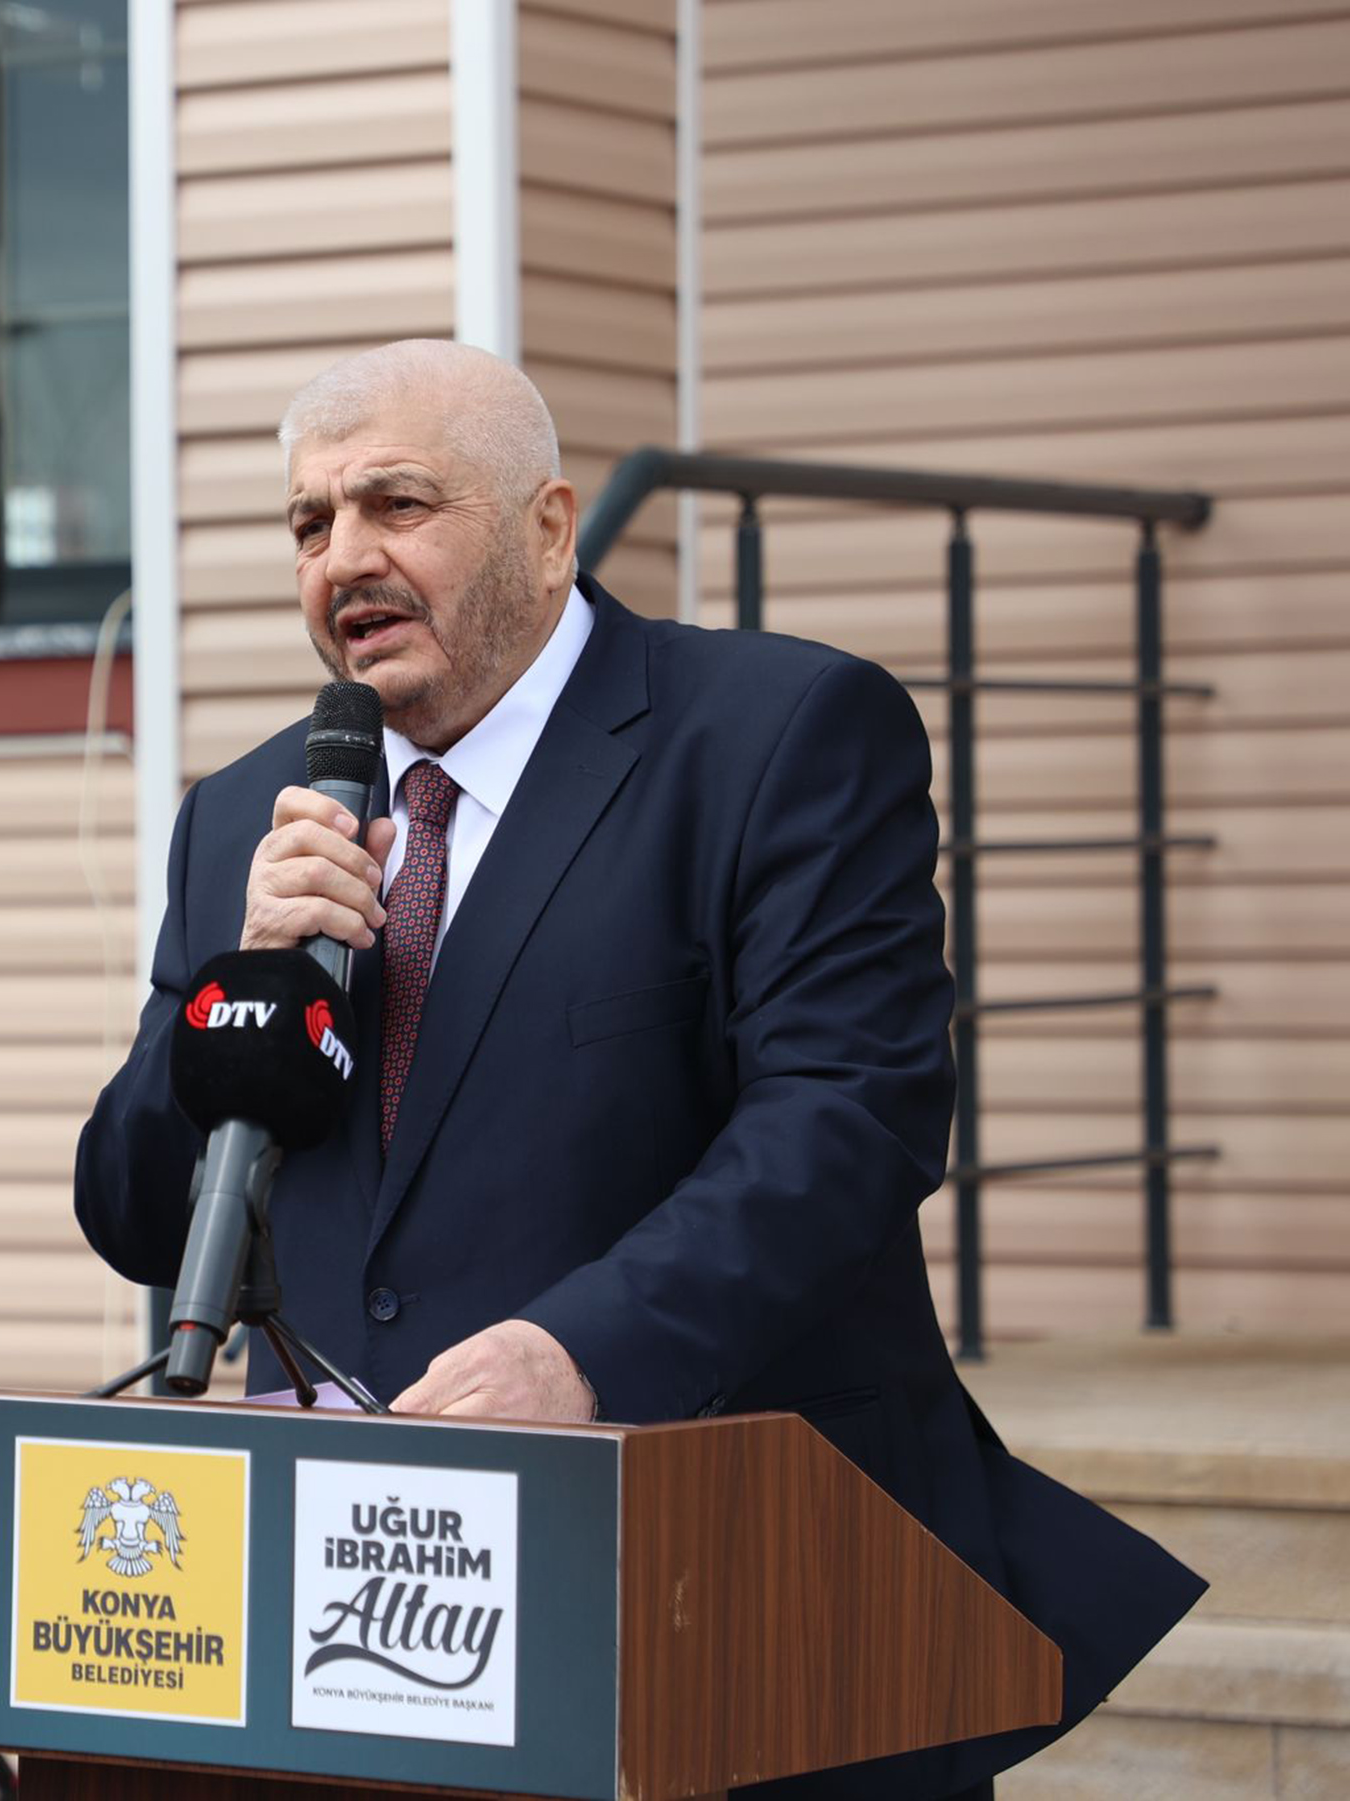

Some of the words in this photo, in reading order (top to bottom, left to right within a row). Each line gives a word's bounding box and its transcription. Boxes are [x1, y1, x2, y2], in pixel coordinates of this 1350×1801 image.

[206, 1000, 278, 1029] DTV
[319, 1026, 354, 1081] DTV
[351, 1494, 464, 1543] UĞUR
[324, 1537, 491, 1580] İBRAHİM
[81, 1588, 177, 1622] KONYA
[33, 1615, 225, 1667] BÜYÜKŞEHİR
[304, 1576, 504, 1690] Altay
[71, 1662, 185, 1691] BELEDİYESİ
[312, 1686, 345, 1699] KONYA
[347, 1688, 404, 1705] BÜYÜKŞEHİR
[406, 1694, 450, 1708] BELEDİYE
[452, 1698, 495, 1712] BAŞKANI
